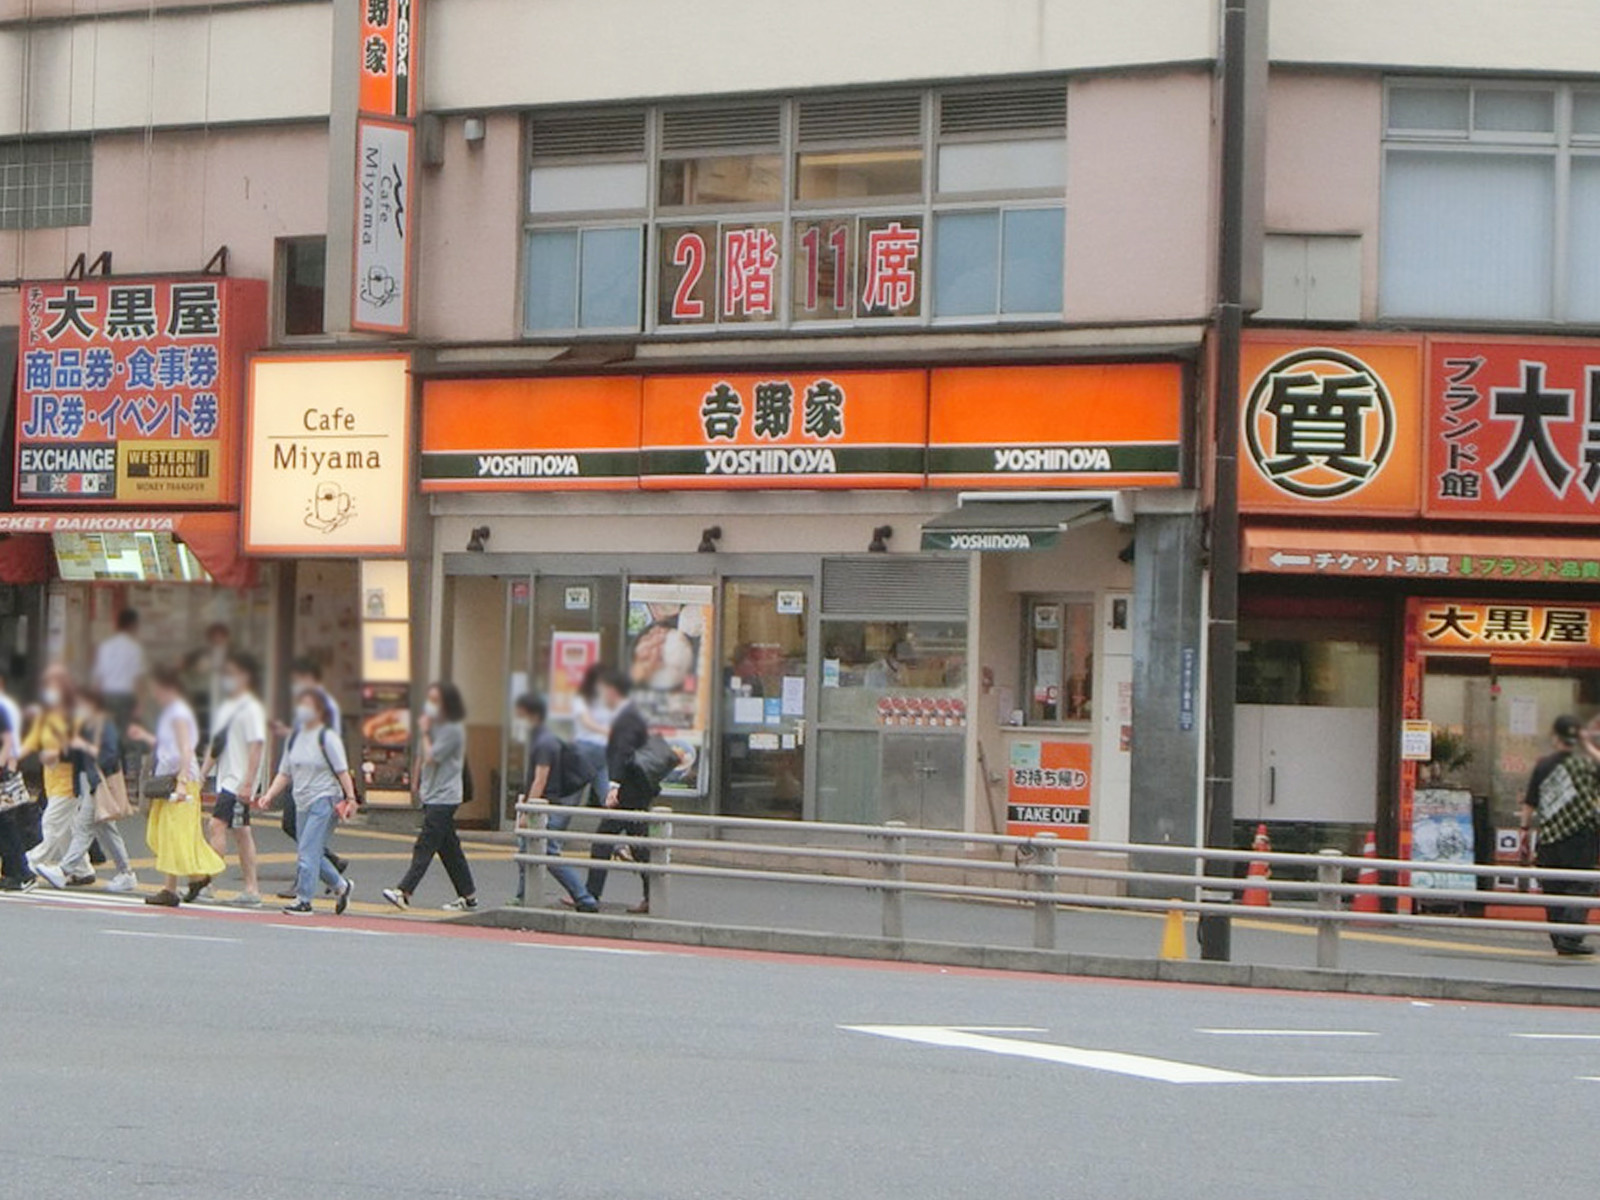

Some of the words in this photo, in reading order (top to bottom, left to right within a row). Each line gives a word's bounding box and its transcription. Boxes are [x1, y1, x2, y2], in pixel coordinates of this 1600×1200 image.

[362, 147, 378, 246] Miyama
[379, 175, 392, 223] Cafe
[28, 286, 43, 345] チケット
[46, 283, 221, 341] 大黒屋
[303, 408, 355, 431] Cafe
[700, 379, 846, 441] 吉野家
[1260, 370, 1378, 481] 質
[1439, 356, 1486, 500] ブランド館
[21, 448, 115, 472] EXCHANGE
[128, 450, 196, 463] WESTERN
[274, 444, 382, 476] Miyama
[477, 454, 580, 477] YOSHINOYA
[704, 449, 837, 474] YOSHINOYA
[994, 448, 1111, 471] YOSHINOYA
[149, 463, 196, 476] UNION
[136, 482, 164, 491] MONEY
[55, 517, 173, 530] DAIKOKUYA
[949, 533, 1031, 550] YOSHINOYA
[1427, 606, 1590, 644] 大黒屋
[1013, 768, 1088, 790] お持ち帰り
[1015, 807, 1051, 821] TAKE
[1052, 808, 1082, 823] OUT
